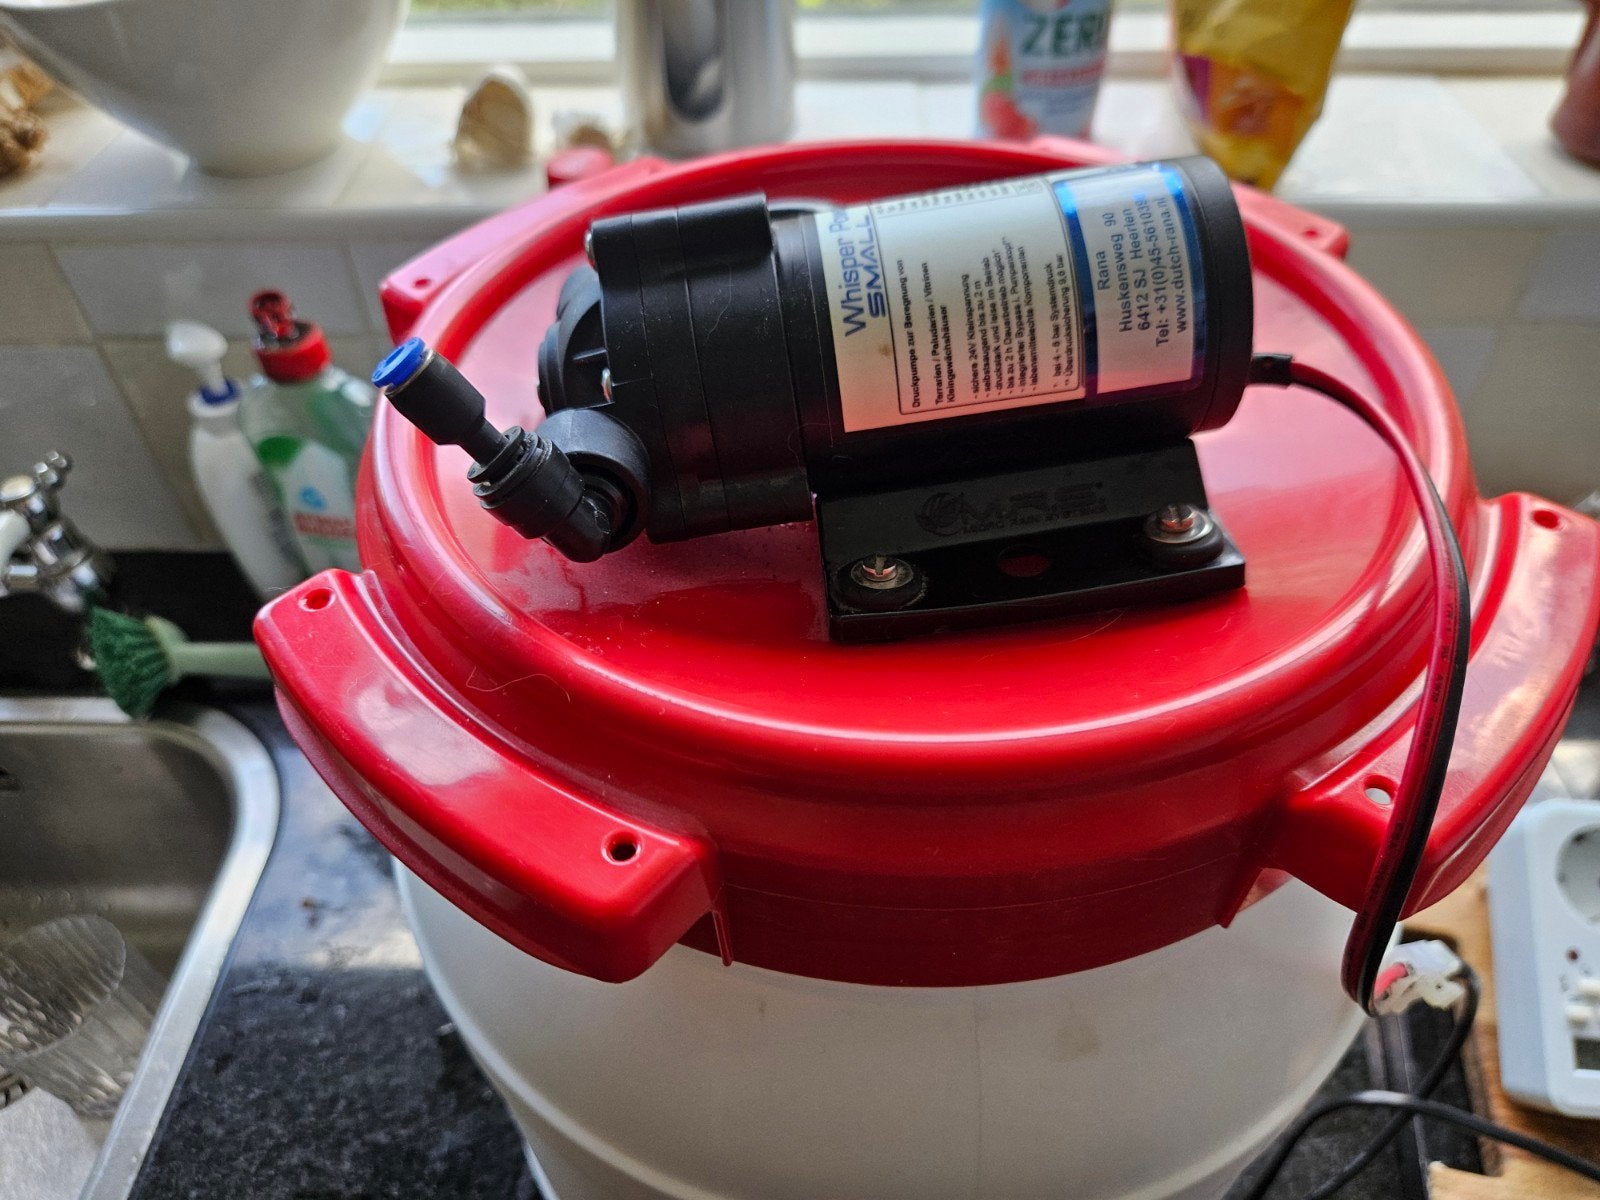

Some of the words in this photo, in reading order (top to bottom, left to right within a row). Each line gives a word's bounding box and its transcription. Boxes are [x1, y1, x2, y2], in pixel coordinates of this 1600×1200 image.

[1102, 212, 1116, 227] 90
[1122, 208, 1143, 260] Heerlen
[838, 238, 867, 337] Whisper
[855, 214, 887, 319] SMALL
[896, 259, 904, 276] von
[921, 262, 932, 298] Vitrinen
[982, 257, 993, 287] Betrieb
[1018, 246, 1032, 306] Komponenten
[1096, 251, 1110, 290] Rana
[1111, 233, 1132, 332] Huskensweg
[1133, 269, 1147, 288] SJ
[1155, 198, 1187, 333] www.dutch-rana.nl
[899, 276, 913, 329] Beregnung
[961, 273, 976, 340] Kleinspannung
[989, 302, 999, 324] leise
[1044, 263, 1060, 321] Systemdruck
[1136, 293, 1150, 331] 6412
[928, 304, 940, 357] Paludarien
[978, 312, 987, 327] bis
[990, 326, 1000, 343] und
[999, 286, 1012, 345] Dauerbetrieb
[1014, 304, 1024, 338] Bypass
[1156, 319, 1169, 347] Tel:
[906, 331, 915, 347] zur
[940, 305, 956, 403] Kleingewächshäuser
[980, 328, 991, 392] selbstsaugend
[1026, 308, 1038, 386] lebensmittelechte
[909, 348, 921, 408] Druckpumpe
[934, 363, 944, 405] Terrarien
[970, 362, 980, 393] sichere
[993, 345, 1003, 390] druckstark
[1006, 376, 1014, 389] bis
[1017, 340, 1027, 386] integrierter
